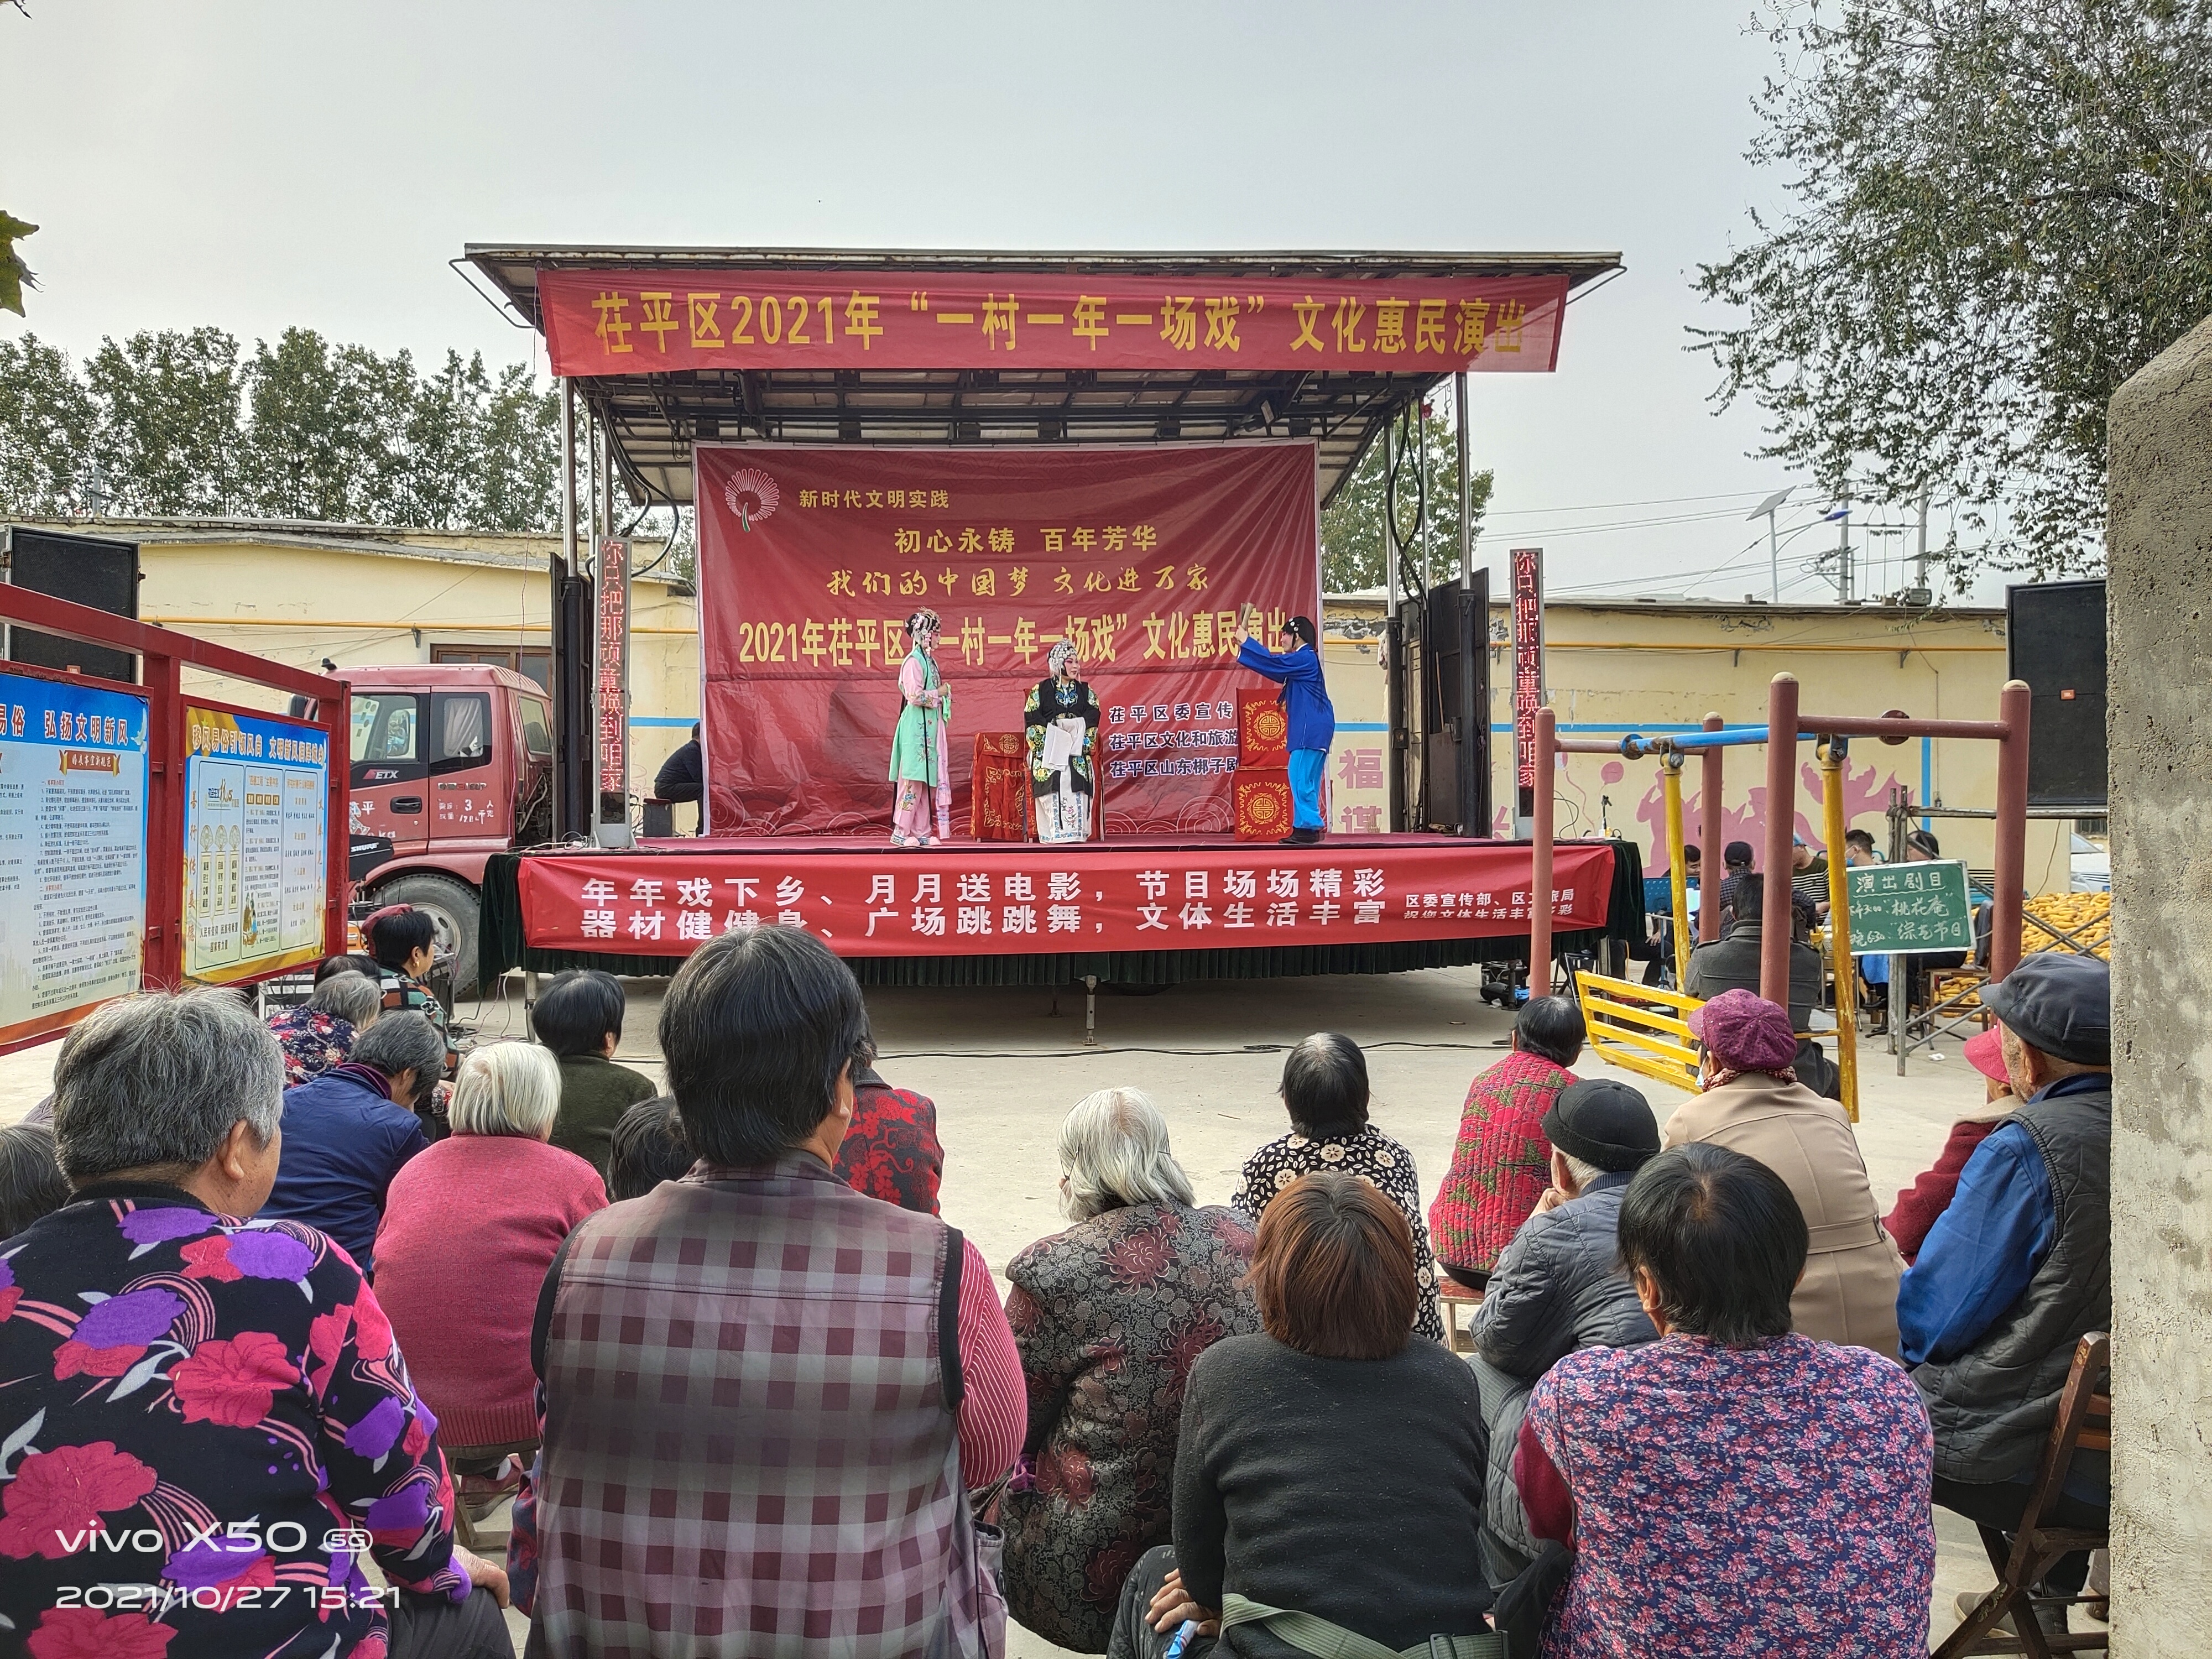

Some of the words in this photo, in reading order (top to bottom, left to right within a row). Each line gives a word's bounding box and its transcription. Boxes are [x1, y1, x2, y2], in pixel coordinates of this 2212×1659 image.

[592, 291, 883, 356] 茌平区2021年
[911, 290, 1264, 353] “一村一年一场戏”
[1290, 295, 1526, 354] 文化惠民演出
[800, 489, 950, 509] 新时代文明实践
[894, 526, 1015, 554] 初心永铸
[1040, 525, 1157, 552] 百年芳华
[826, 566, 1029, 597] 我们的中国梦
[1053, 564, 1208, 596] 文化进万家
[939, 613, 1128, 666] 一村一年一场戏”
[44, 709, 128, 746] 弘扬文明新风
[1109, 701, 1234, 724] 茌平区委宣传
[192, 724, 263, 757] 移风易俗引领风尚
[375, 770, 399, 779] ETX
[1338, 749, 1384, 789] 福
[1856, 871, 1941, 893] 演出剧目
